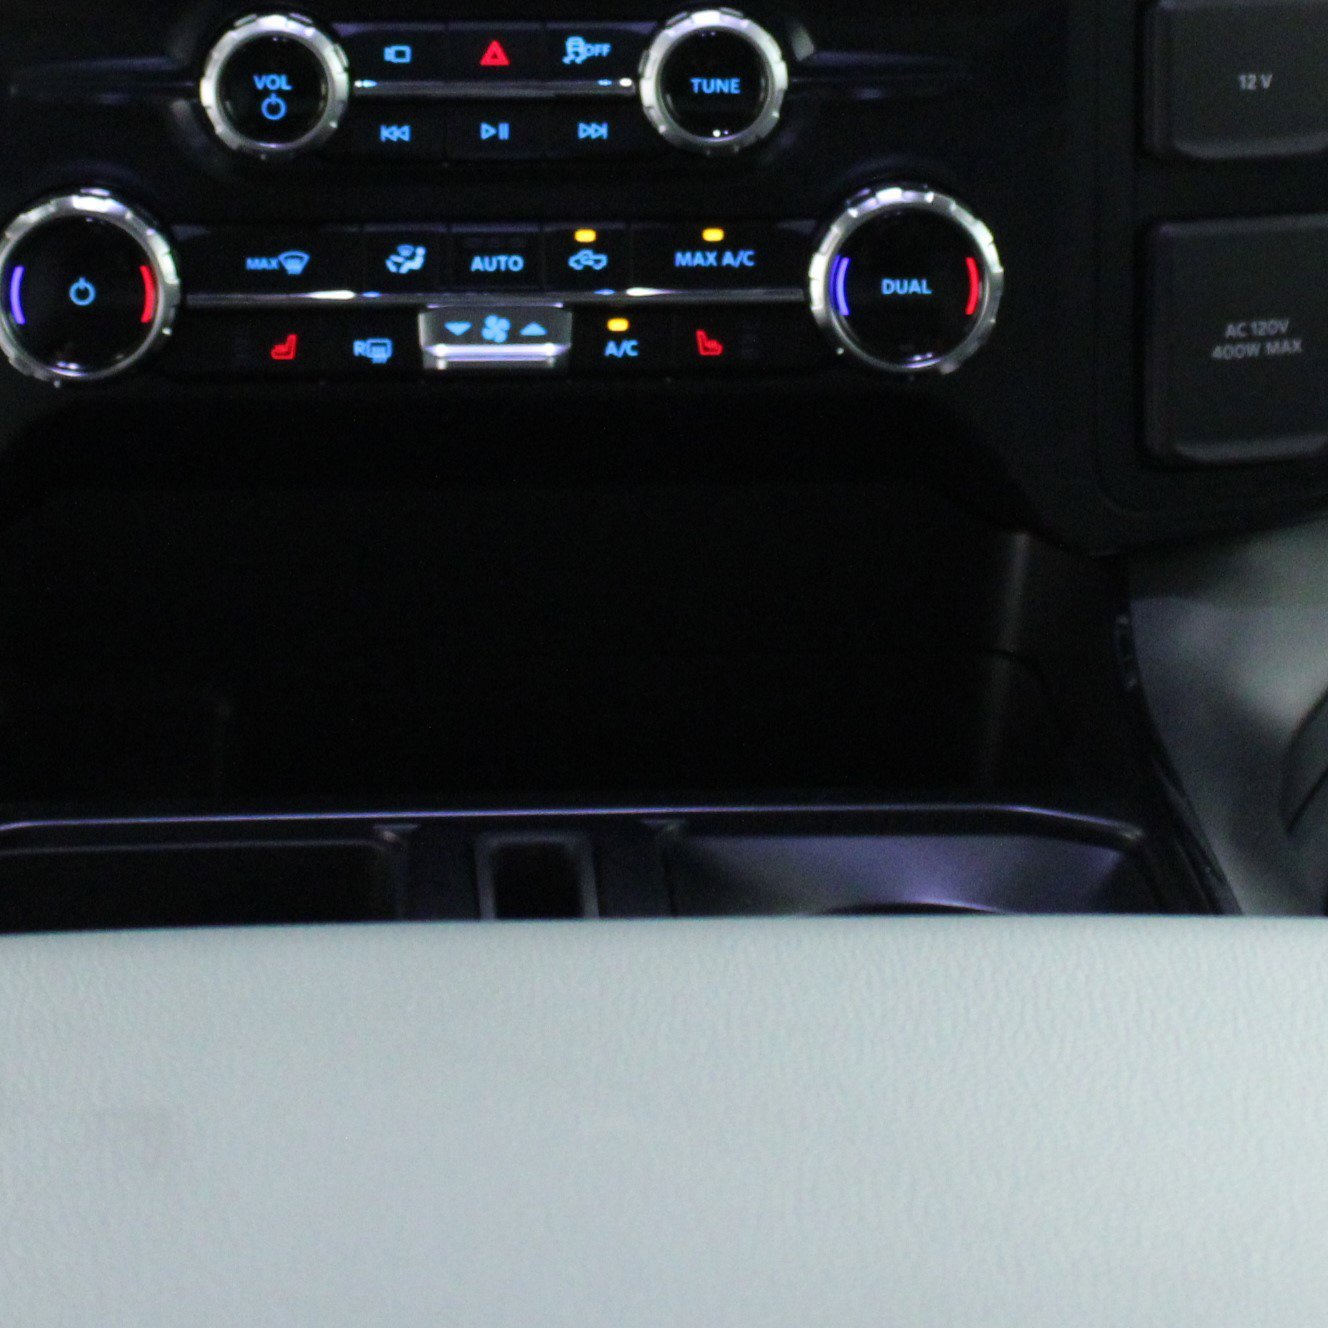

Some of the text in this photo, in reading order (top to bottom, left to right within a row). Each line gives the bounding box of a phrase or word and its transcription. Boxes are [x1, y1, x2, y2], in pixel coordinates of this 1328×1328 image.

[254, 76, 292, 90] VOL
[691, 78, 740, 94] TUNE
[1239, 74, 1272, 90] 12 V
[246, 257, 278, 270] MAX
[471, 255, 524, 272] AUTO
[675, 249, 755, 268] MAX A/C
[881, 278, 932, 295] DUAL
[1226, 323, 1248, 338] AC
[604, 339, 639, 356] A/C
